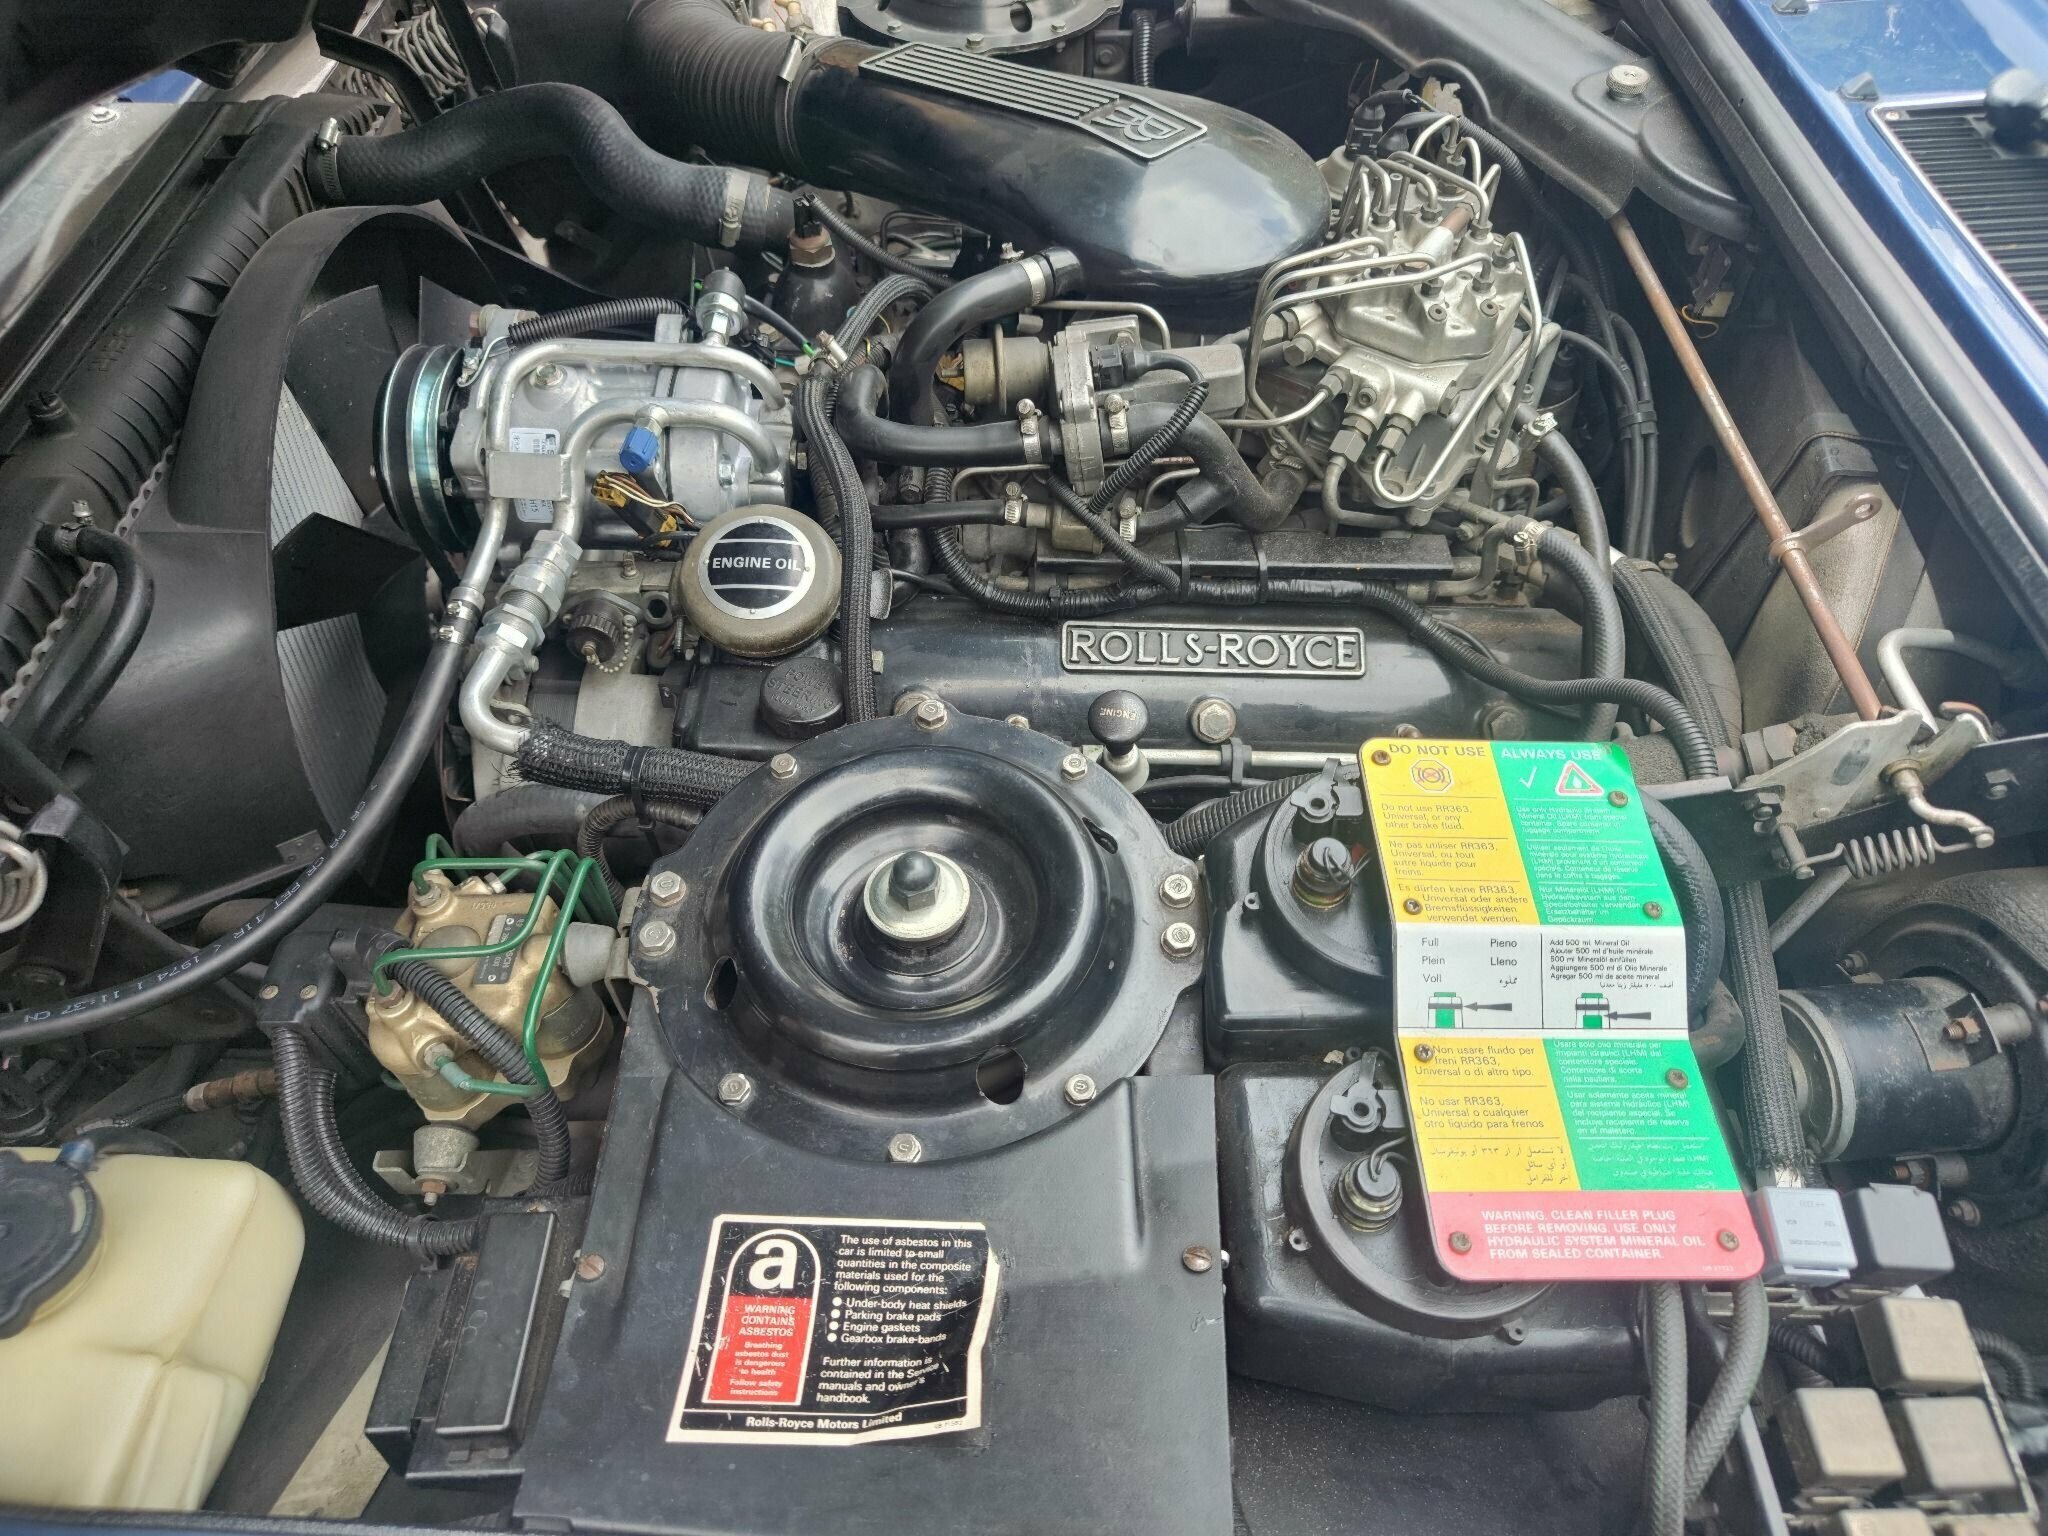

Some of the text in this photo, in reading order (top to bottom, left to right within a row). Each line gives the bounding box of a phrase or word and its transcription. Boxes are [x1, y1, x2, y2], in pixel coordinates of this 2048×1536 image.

[712, 557, 801, 571] ENGINE OIL
[1069, 628, 1358, 669] ROLLS-ROYCE
[1099, 706, 1137, 722] ENGINE
[1389, 744, 1486, 756] DO NOT USE
[1502, 748, 1602, 760] ALWAYS USE
[1381, 803, 1394, 811] Do
[1435, 805, 1473, 814] RR363,
[1444, 815, 1461, 823] any
[1385, 820, 1409, 828] other
[1441, 822, 1464, 830] fluid.
[1421, 937, 1439, 947] Full
[1490, 939, 1517, 947] Pieno
[1421, 955, 1445, 965] Plein
[1490, 957, 1517, 966] Lleno
[1423, 973, 1442, 983] Voll
[1432, 1046, 1454, 1054] Non
[1487, 1046, 1515, 1054] fluido
[1519, 1047, 1534, 1056] per
[1434, 1056, 1500, 1067] freni RR363,
[1414, 1066, 1461, 1076] Universal
[1474, 1068, 1484, 1076] di
[1487, 1068, 1510, 1076] altro
[1420, 1097, 1504, 1107] No usar RR363,
[1422, 1107, 1469, 1117] Universal
[1483, 1108, 1529, 1119] cualquier
[1424, 1120, 1445, 1128] otro
[1486, 1120, 1508, 1130] para
[1481, 1210, 1676, 1221] WARNING. CLEAN FILLER PLUG
[1485, 1223, 1677, 1234] BEFORE REMOVING. USE ONLY
[840, 1234, 859, 1245] The
[883, 1237, 893, 1245] of
[895, 1238, 938, 1247] asbestos
[942, 1239, 951, 1247] in
[954, 1238, 972, 1248] this
[1488, 1236, 1560, 1246] HYDRAULIC
[1565, 1236, 1617, 1246] SYSTEM
[1621, 1236, 1679, 1246] MINERAL
[838, 1248, 944, 1258] car is limited to small
[1489, 1249, 1528, 1259] FROM
[1532, 1248, 1581, 1259] SEALED
[748, 1238, 798, 1289] a
[837, 1258, 971, 1272] quantities in the composite
[835, 1270, 944, 1282] materials used for the
[834, 1282, 948, 1295] following components:
[745, 1304, 796, 1314] WARNING
[846, 1297, 967, 1311] Under-body heat shields
[741, 1315, 795, 1326] CONTAINS
[844, 1309, 942, 1322] Parking brake pads
[739, 1327, 793, 1336] ASBESTOS
[842, 1322, 921, 1333] Engine gaskets
[840, 1333, 947, 1344] Gearbox brake-bands
[744, 1342, 783, 1350] Breathing
[744, 1359, 785, 1367] dangerous
[822, 1357, 933, 1367] Further information is
[820, 1362, 939, 1379] contained in the Service
[758, 1380, 783, 1388] safety
[818, 1377, 926, 1392] manuals and owner's
[730, 1388, 778, 1396] instructions
[816, 1393, 870, 1403] handbook.
[745, 1413, 903, 1430] Rolls-Royce Motors Limited
